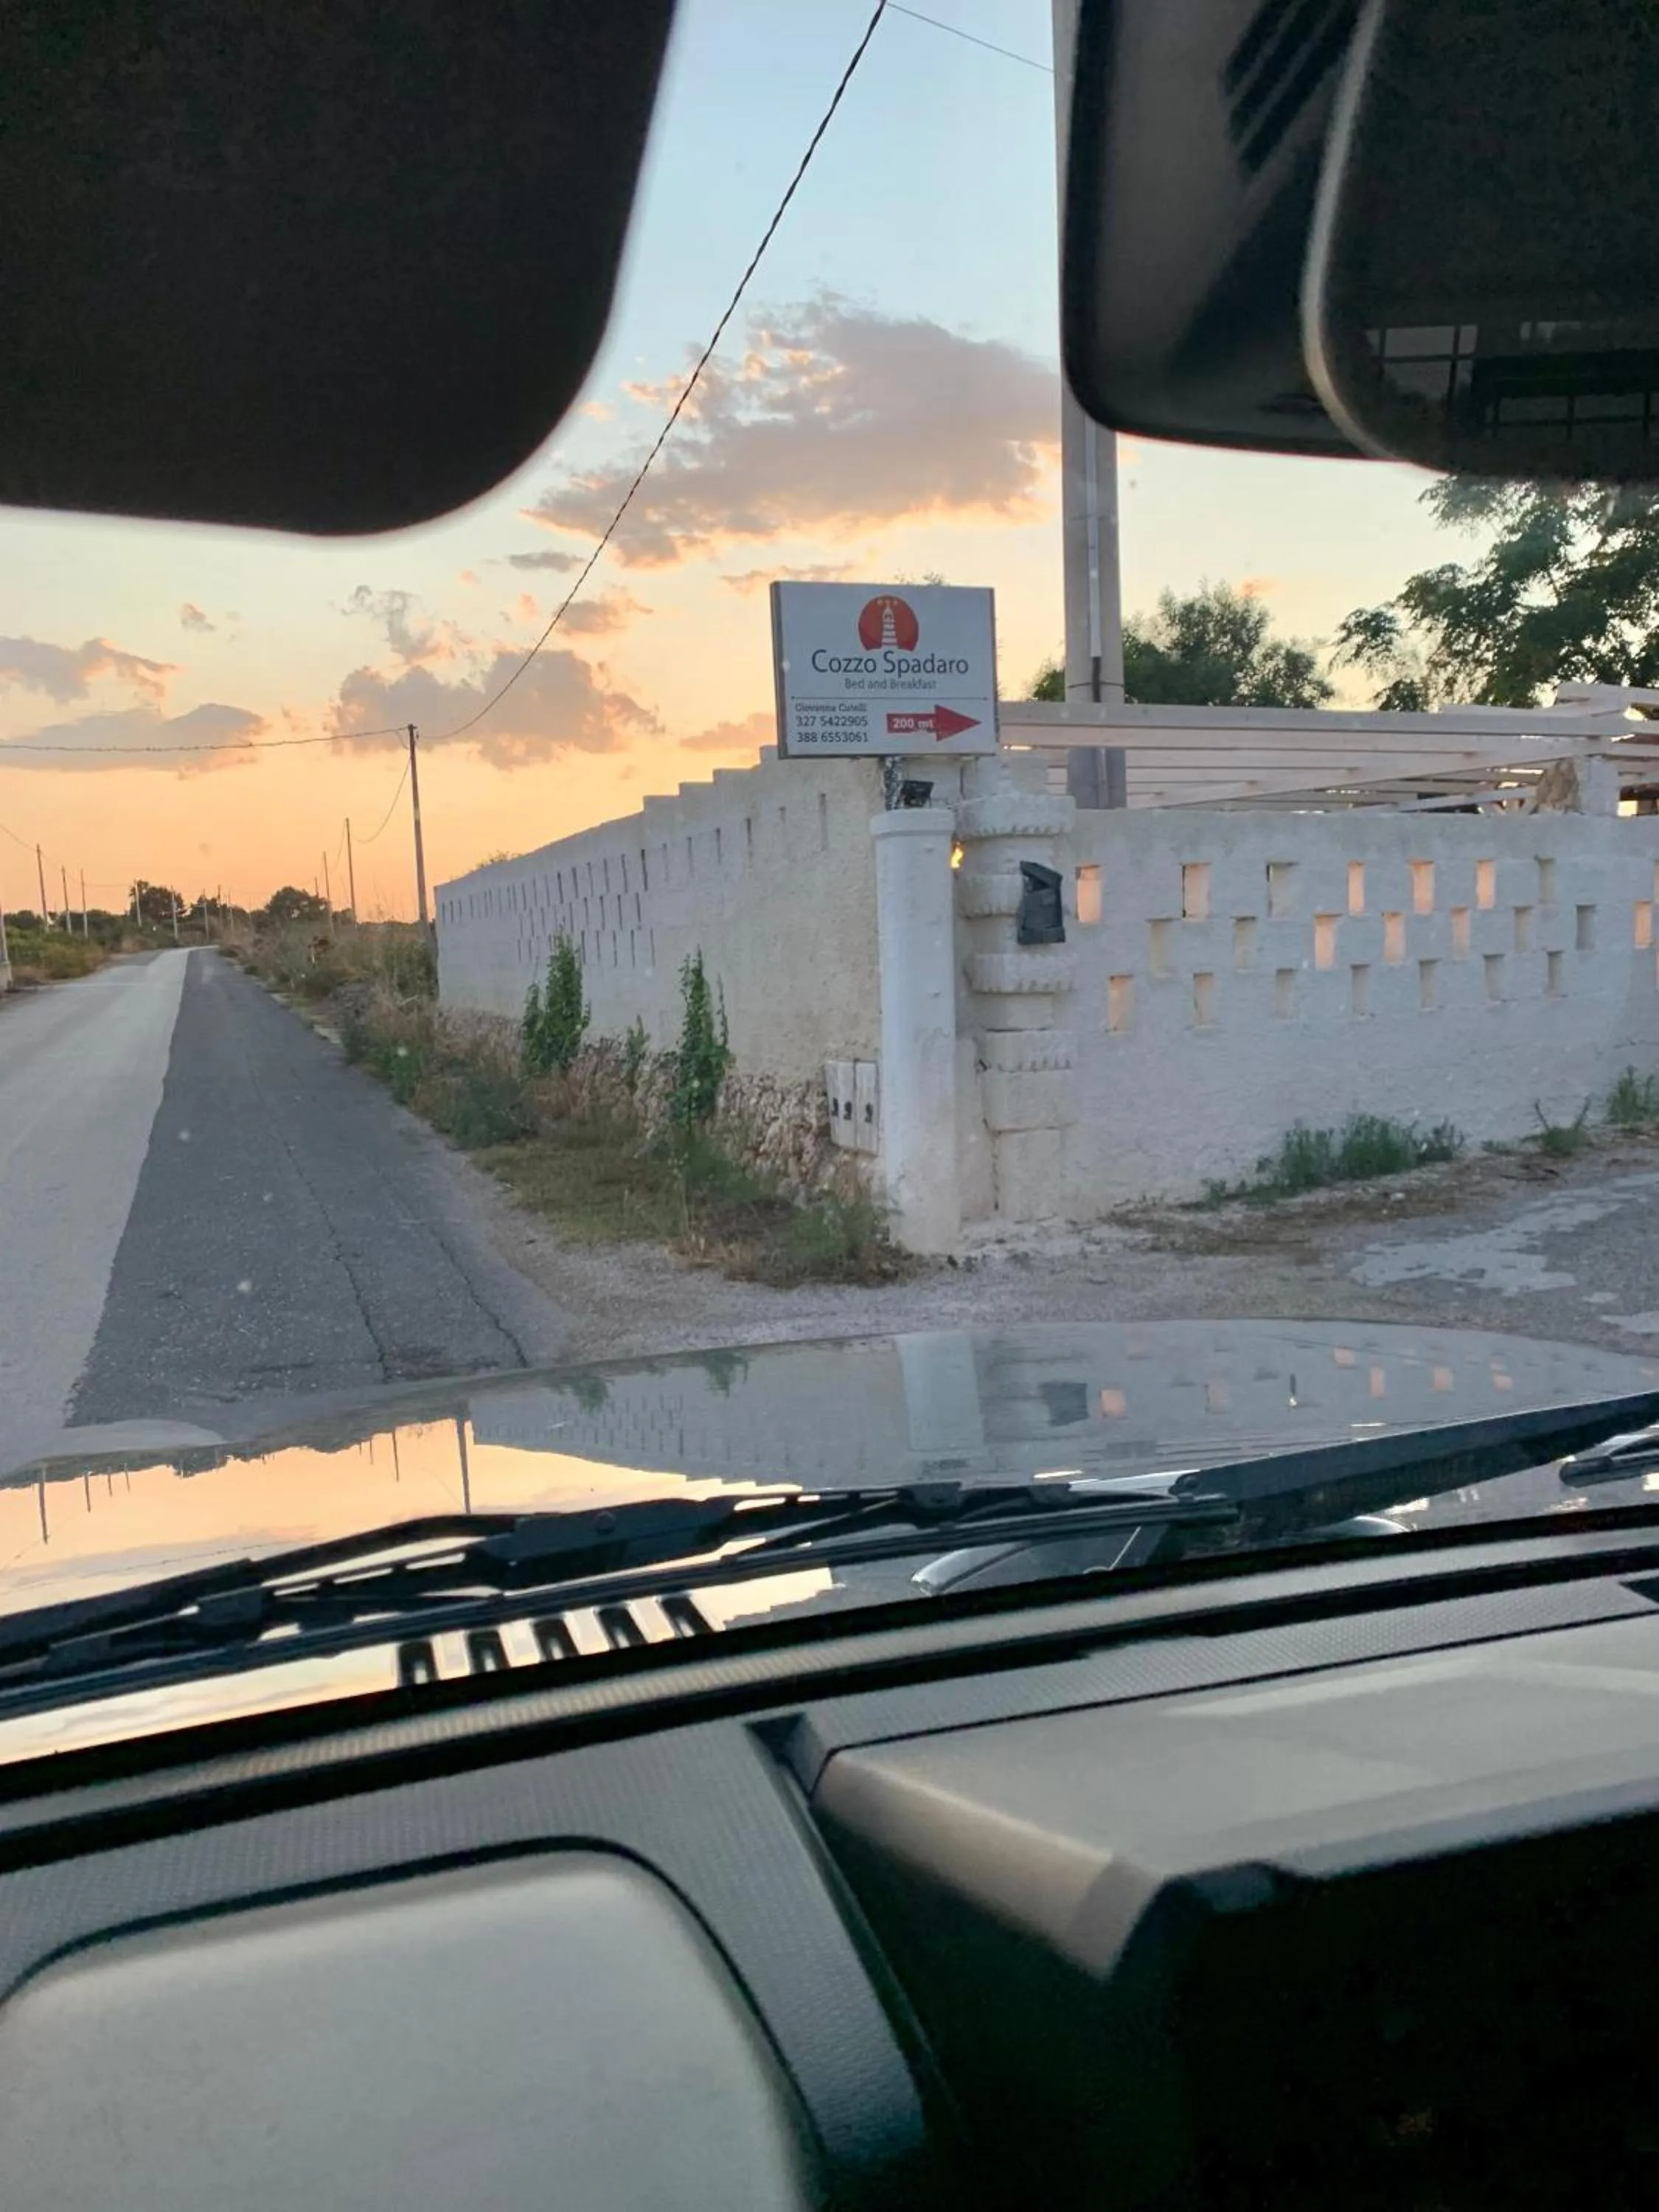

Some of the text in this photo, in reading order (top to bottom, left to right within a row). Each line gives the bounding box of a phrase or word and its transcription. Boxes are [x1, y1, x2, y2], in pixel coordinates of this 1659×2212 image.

[812, 649, 969, 678] Cozzo Spadaro
[845, 678, 936, 689] Bed and Breakfast
[796, 715, 869, 727] 327 5422905
[892, 717, 934, 729] 200 mt
[796, 731, 818, 743] 388
